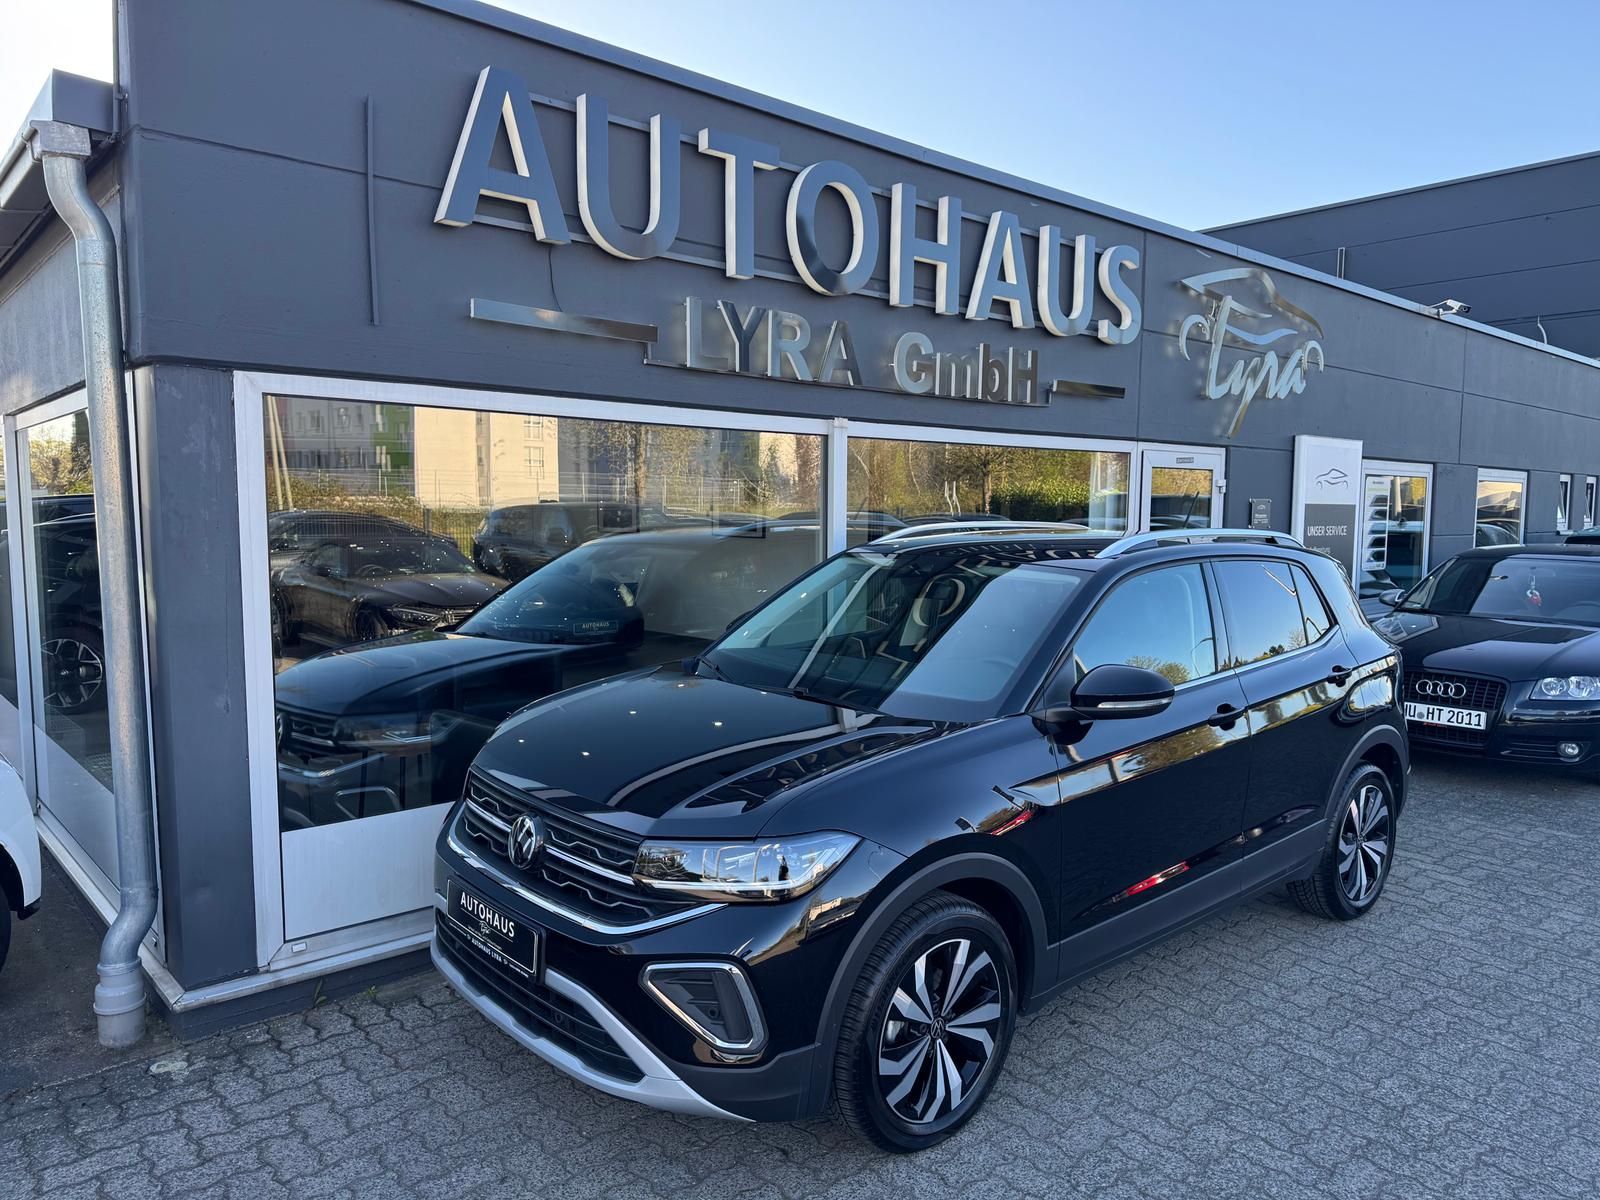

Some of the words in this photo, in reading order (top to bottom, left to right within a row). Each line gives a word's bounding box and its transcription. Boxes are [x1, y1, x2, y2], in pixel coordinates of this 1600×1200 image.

[434, 65, 1142, 346] AUTOHAUS
[685, 297, 862, 387] LYRA
[893, 331, 1039, 404] GmbH
[1307, 525, 1325, 537] UNSER
[1326, 525, 1348, 537] SERVICE
[1426, 706, 1444, 722] HT
[1447, 709, 1482, 727] 2011
[460, 891, 515, 938] AUTOHAUS
